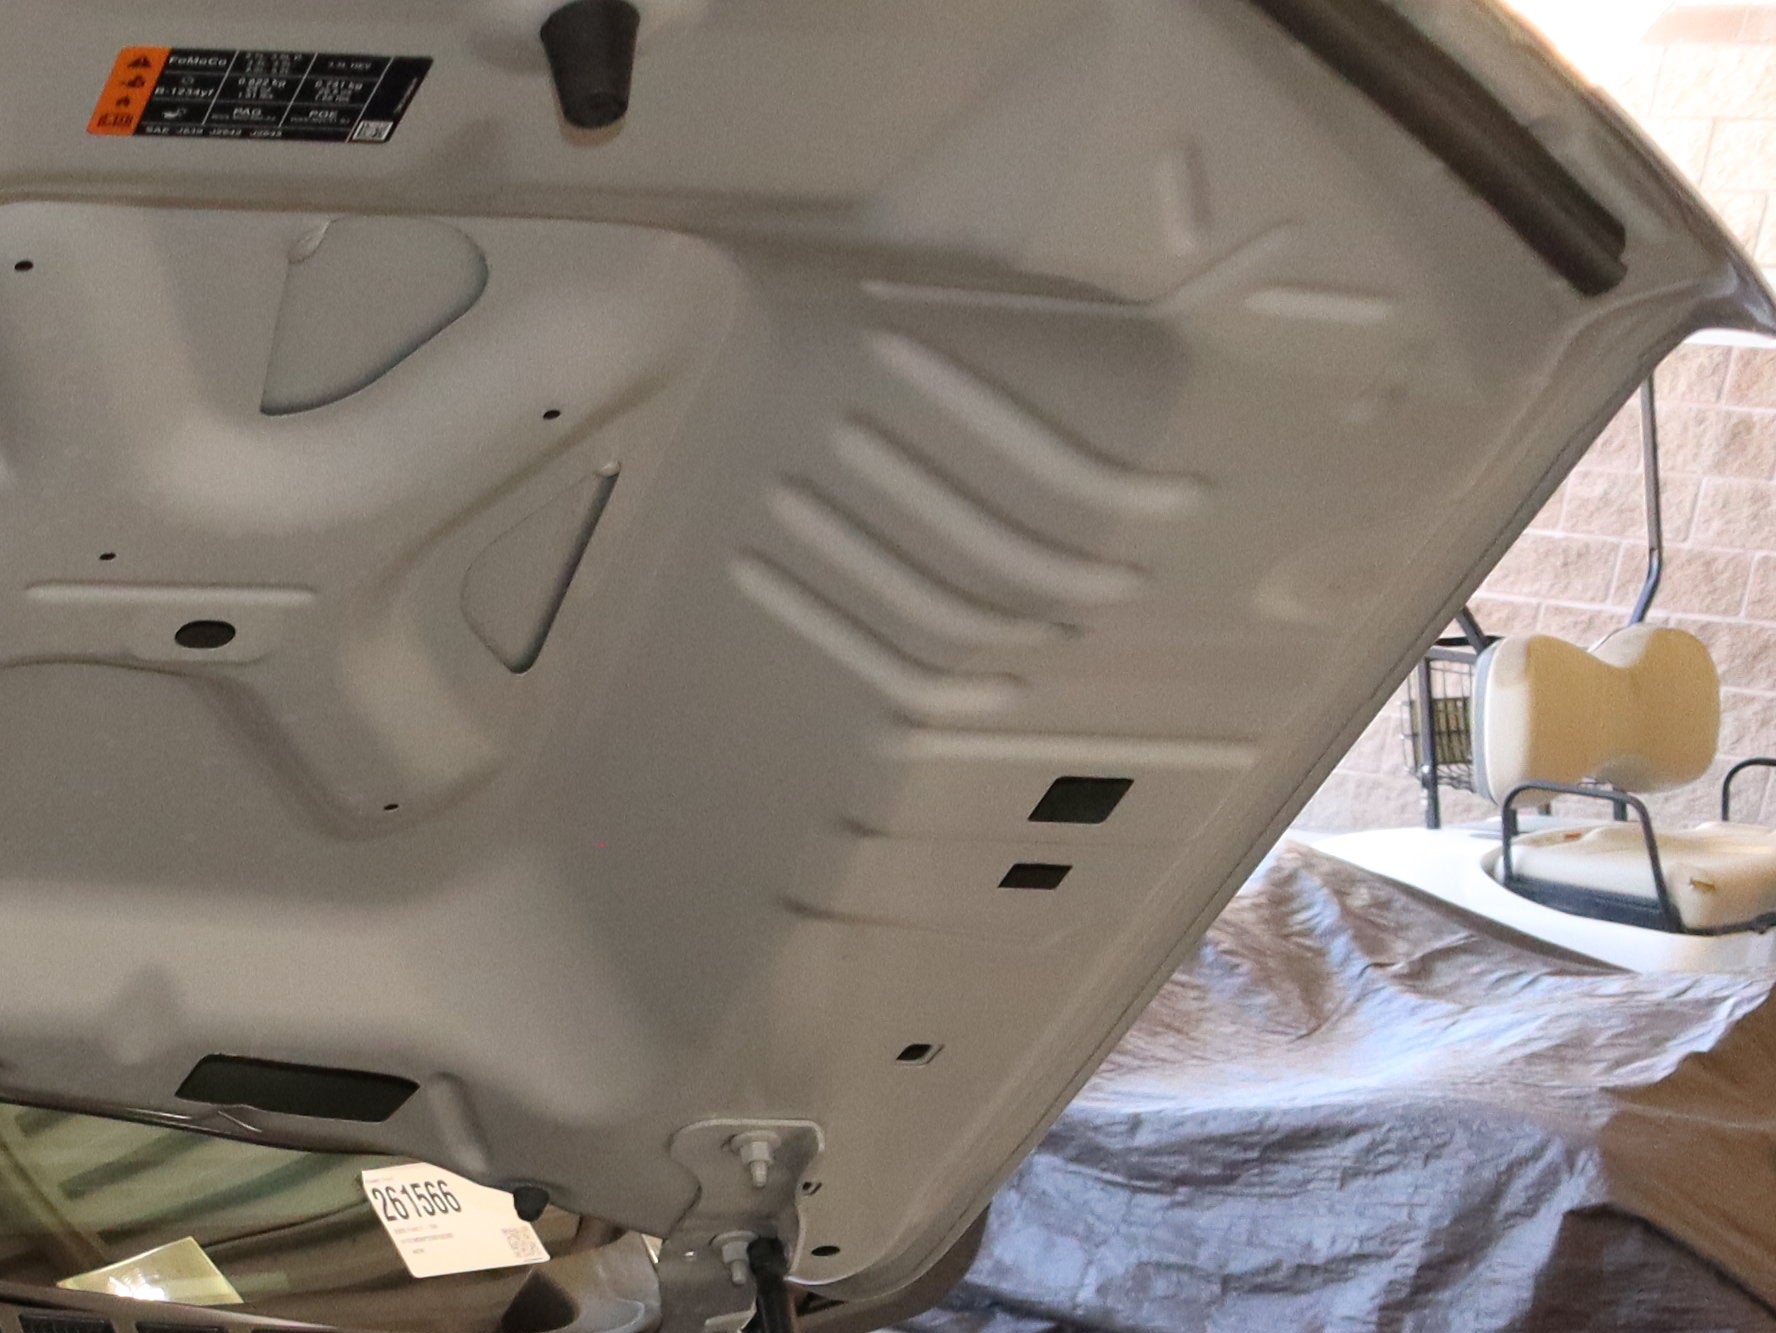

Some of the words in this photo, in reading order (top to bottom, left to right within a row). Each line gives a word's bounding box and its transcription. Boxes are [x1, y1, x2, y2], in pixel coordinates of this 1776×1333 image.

[168, 55, 228, 67] FoMoCo
[154, 86, 215, 98] R-1234yf
[371, 1179, 462, 1222] 261566
